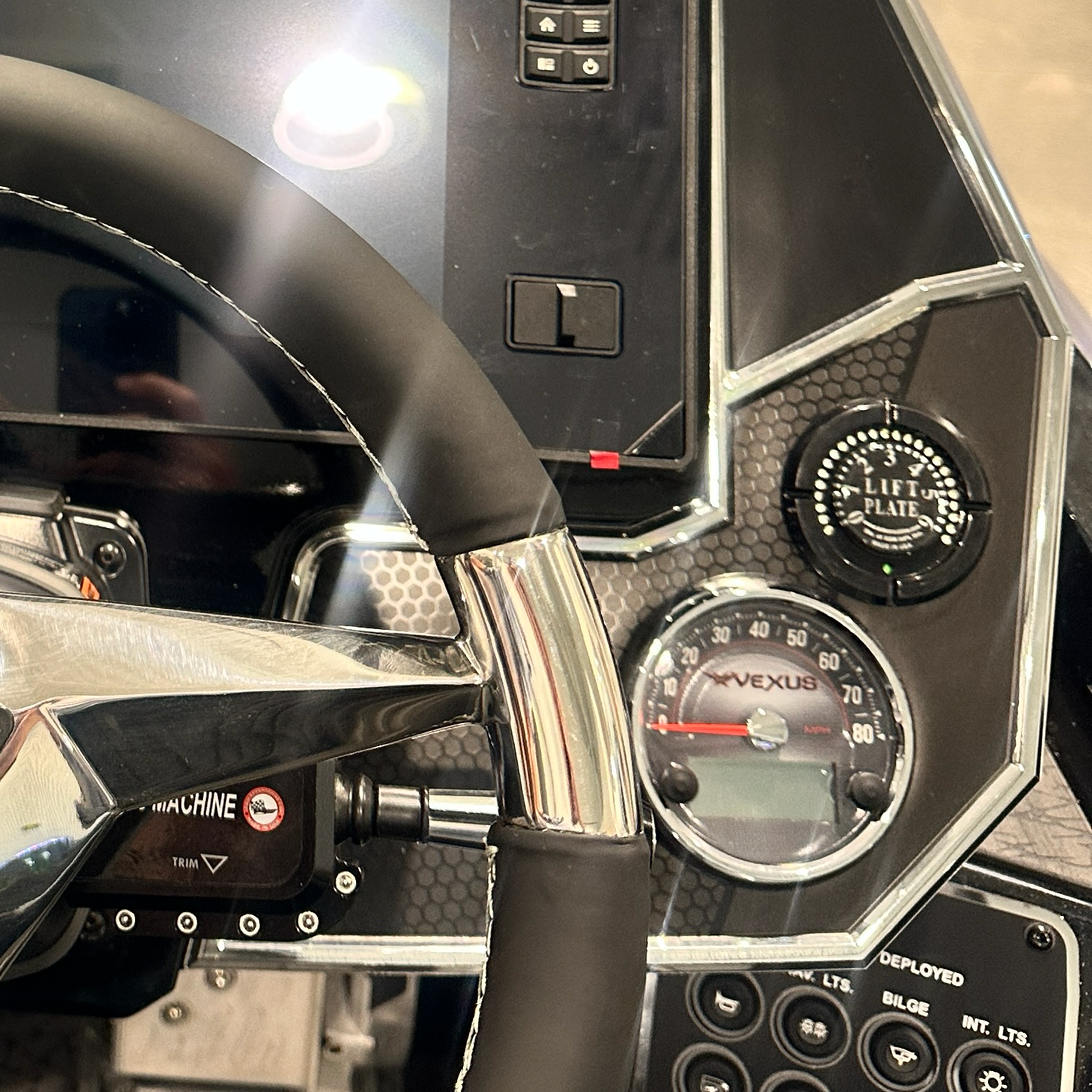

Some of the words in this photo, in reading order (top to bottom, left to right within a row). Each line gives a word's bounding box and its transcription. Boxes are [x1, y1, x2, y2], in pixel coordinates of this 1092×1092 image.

[864, 477, 919, 497] LIFT
[864, 497, 919, 518] PLATE
[711, 626, 731, 644] 30
[749, 621, 769, 639] 40
[787, 628, 807, 647] 50
[681, 646, 699, 665] 20
[819, 652, 840, 671] 60
[664, 677, 678, 696] 10
[734, 672, 818, 691] VEXUS
[842, 684, 862, 705] 70
[852, 723, 874, 745] 80
[172, 856, 199, 870] TRIM
[879, 951, 965, 987] DEPLOYED
[822, 973, 854, 995] LTS.
[882, 990, 930, 1017] BILGE
[962, 1014, 990, 1036] INT.
[997, 1025, 1031, 1048] LTS.
